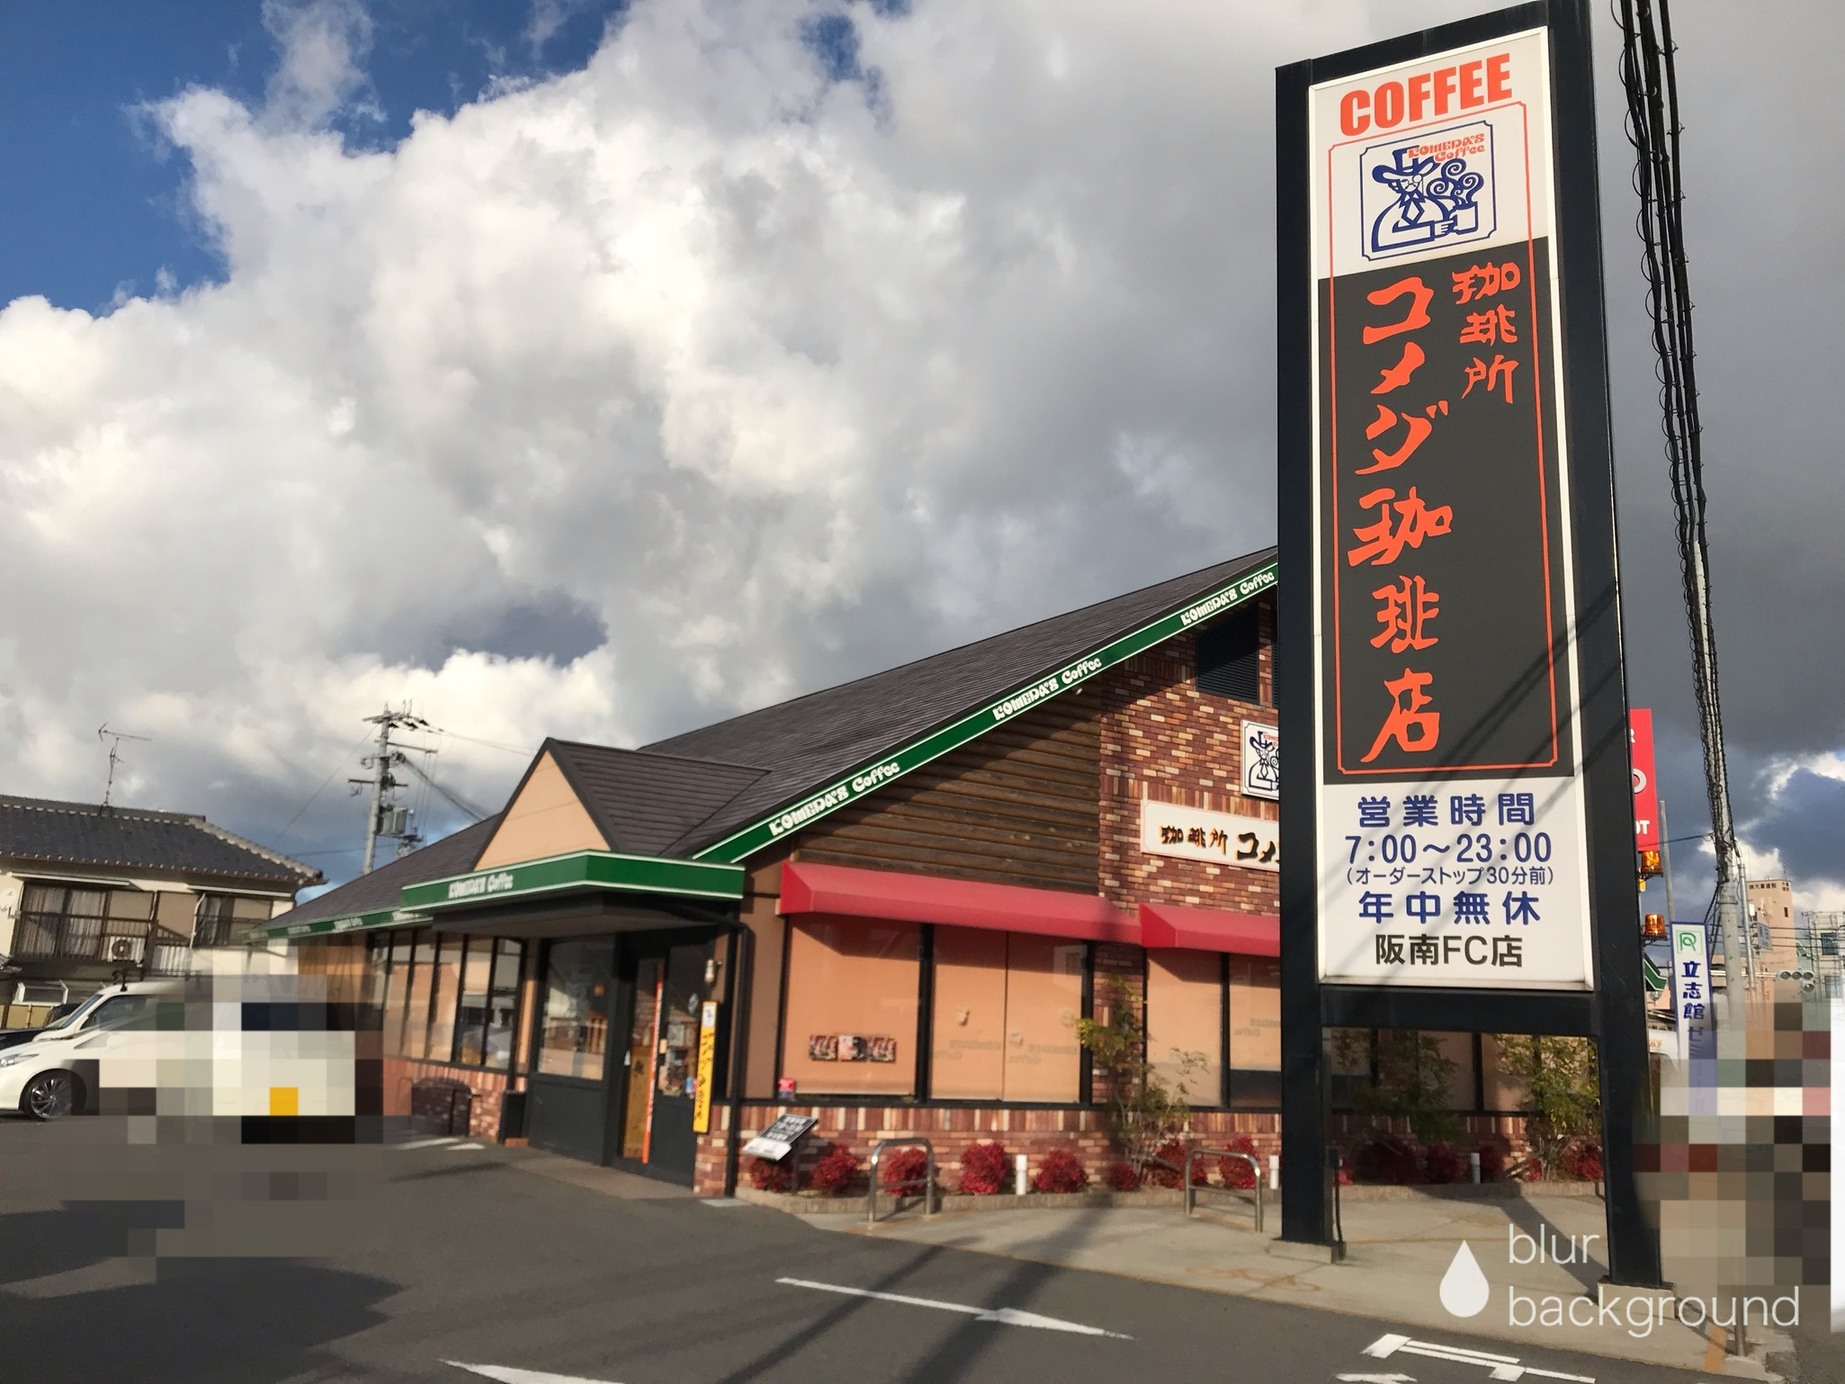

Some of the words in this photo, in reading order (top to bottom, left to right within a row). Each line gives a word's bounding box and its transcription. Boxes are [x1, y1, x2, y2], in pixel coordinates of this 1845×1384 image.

[1340, 53, 1513, 136] COFFEE
[1408, 133, 1485, 158] KOMEDA'S
[1434, 145, 1485, 162] Coffee
[1347, 276, 1454, 763] コメダ珈琲店
[1239, 571, 1275, 595] Coffee
[1061, 657, 1103, 685] Coffee
[768, 784, 850, 837] KOMEDA'S
[851, 762, 901, 793] Coffee
[1357, 792, 1535, 828] 営業時間
[1345, 832, 1551, 864] 7:00～23:00
[1347, 865, 1555, 886] (オーダーストップ30分前)
[1358, 890, 1541, 925] 年中無休
[1375, 933, 1524, 968] 阪南FC店
